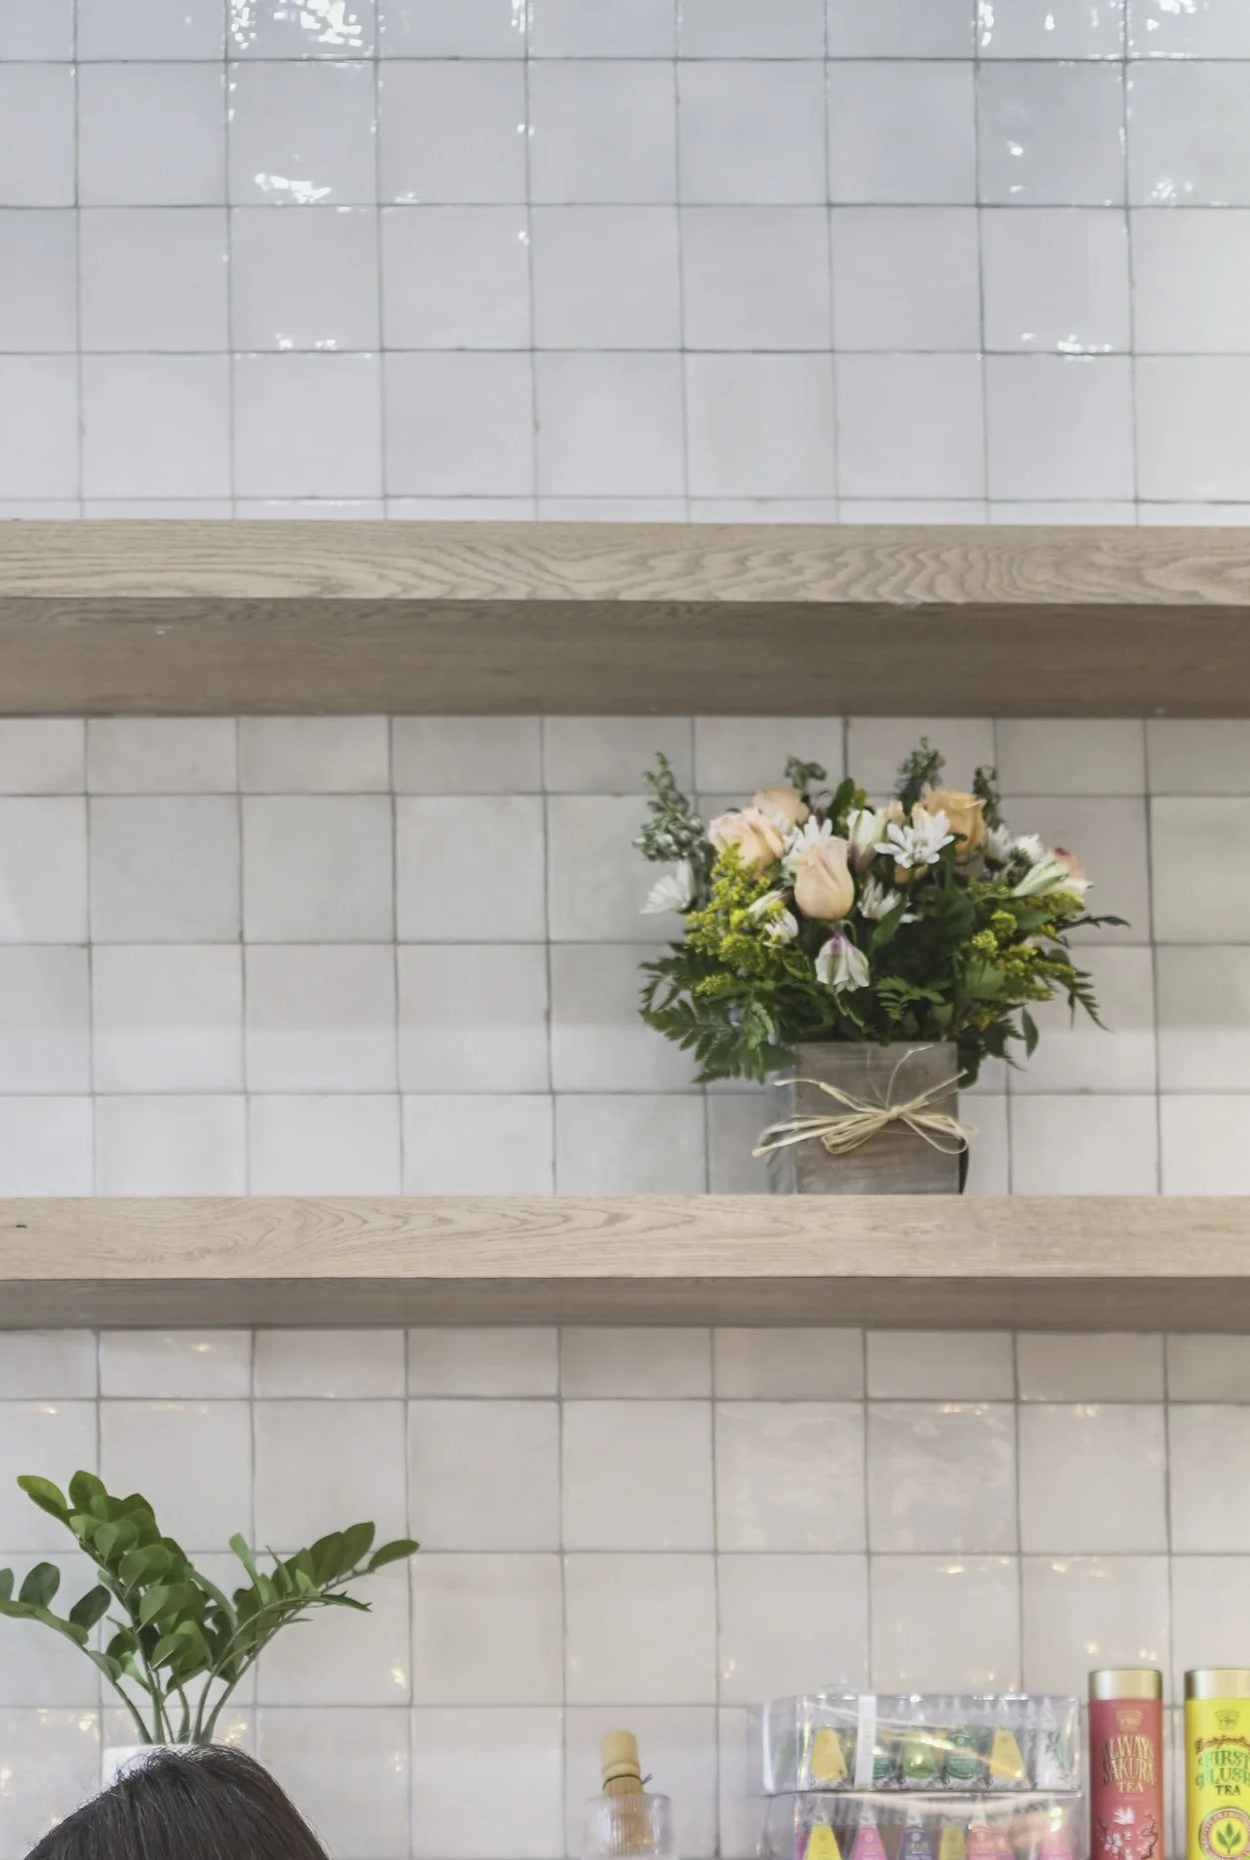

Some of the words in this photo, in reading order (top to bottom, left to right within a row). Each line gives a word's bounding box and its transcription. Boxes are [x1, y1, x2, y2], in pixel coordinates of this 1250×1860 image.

[1102, 1735, 1155, 1762] ALWAYS
[1102, 1756, 1157, 1788] SAKURA
[1117, 1781, 1144, 1792] TEA
[1215, 1785, 1241, 1796] TEA
